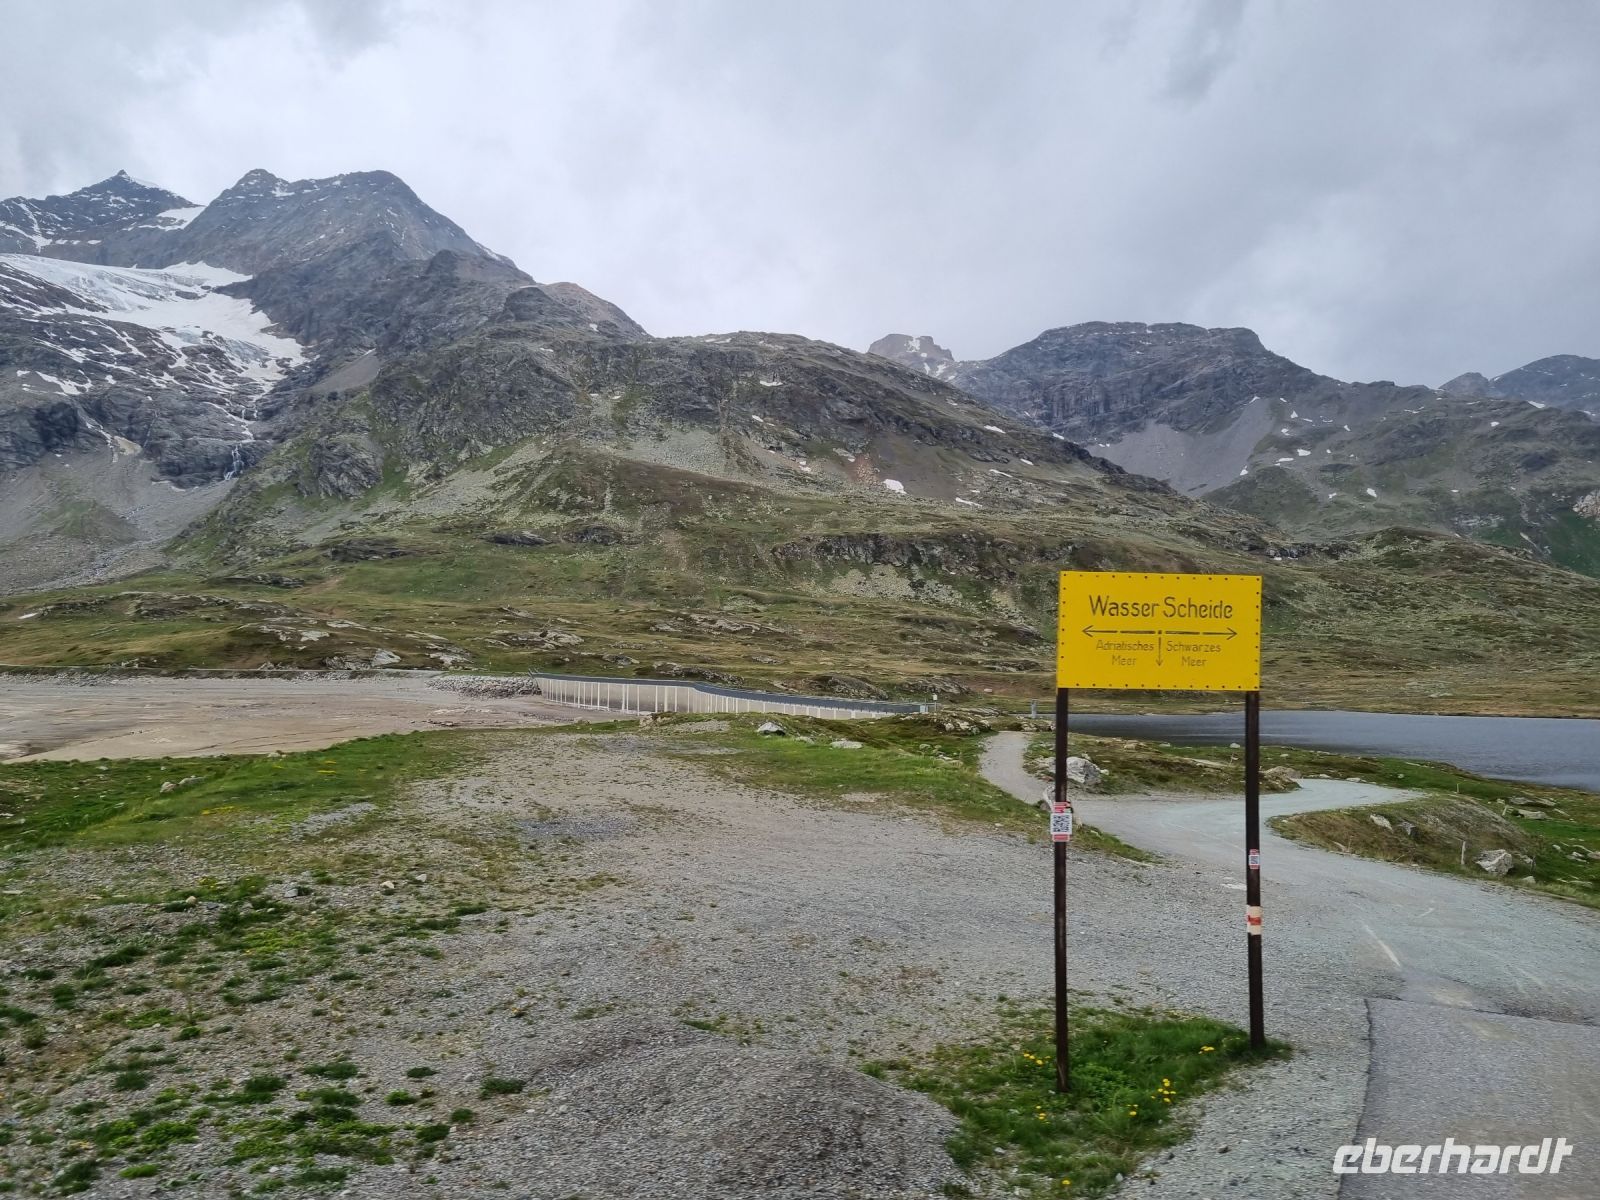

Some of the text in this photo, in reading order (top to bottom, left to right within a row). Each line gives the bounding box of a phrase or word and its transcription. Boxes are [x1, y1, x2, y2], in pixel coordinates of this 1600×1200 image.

[1089, 595, 1233, 619] Wasser Scheide
[1096, 640, 1154, 651] Adriatisches
[1166, 640, 1221, 653] Schwarzes
[1112, 655, 1137, 666] Meer
[1181, 656, 1207, 667] Meer
